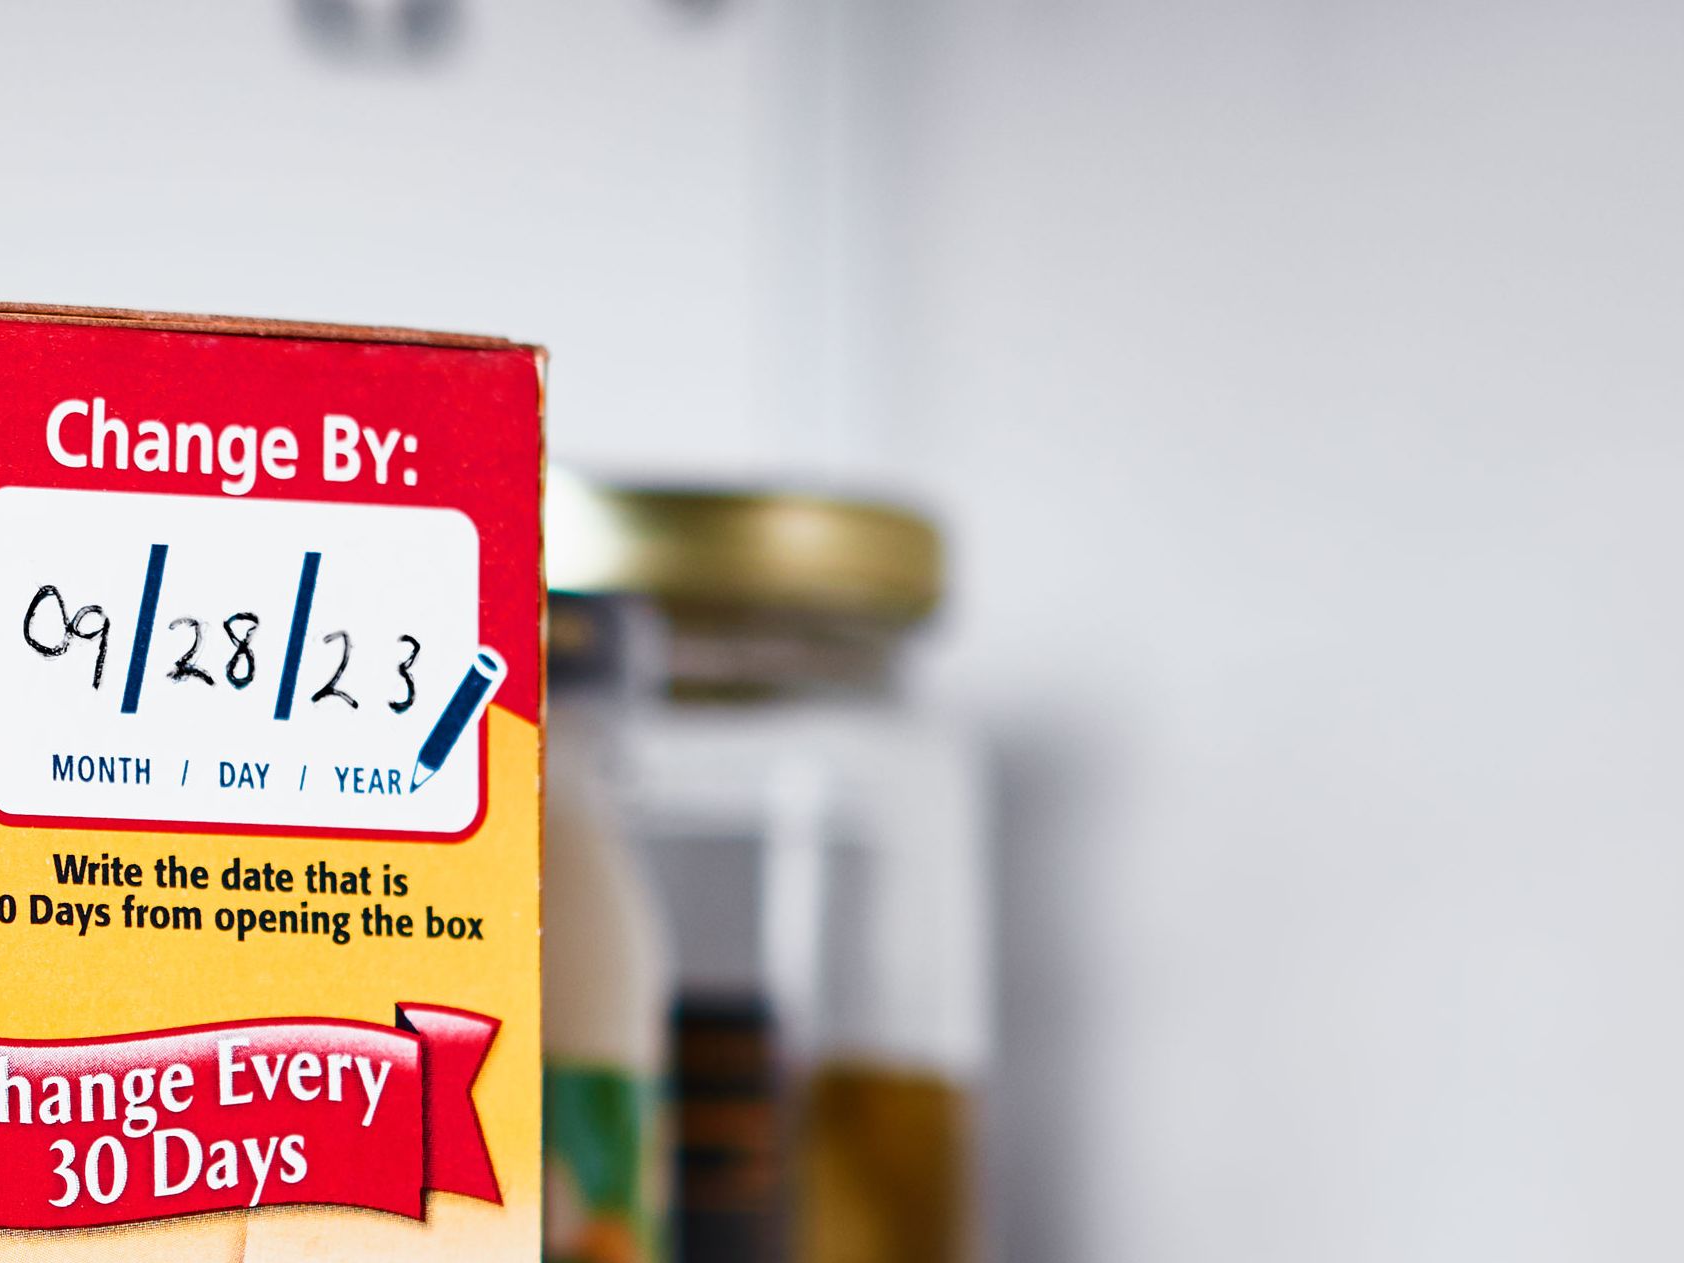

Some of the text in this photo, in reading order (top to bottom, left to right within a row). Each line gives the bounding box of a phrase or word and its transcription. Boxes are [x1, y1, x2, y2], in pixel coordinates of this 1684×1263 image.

[45, 397, 418, 495] Change BY:
[53, 755, 150, 784] MONTH
[220, 762, 269, 788] DAY
[335, 767, 400, 794] YEAR
[53, 853, 408, 896] Write the date that is
[30, 895, 110, 936] Days
[122, 895, 201, 929] from
[215, 902, 350, 944] opening
[361, 904, 413, 937] the
[427, 906, 483, 939] box
[217, 1037, 390, 1127] Every
[48, 1128, 308, 1208] 30 Days
